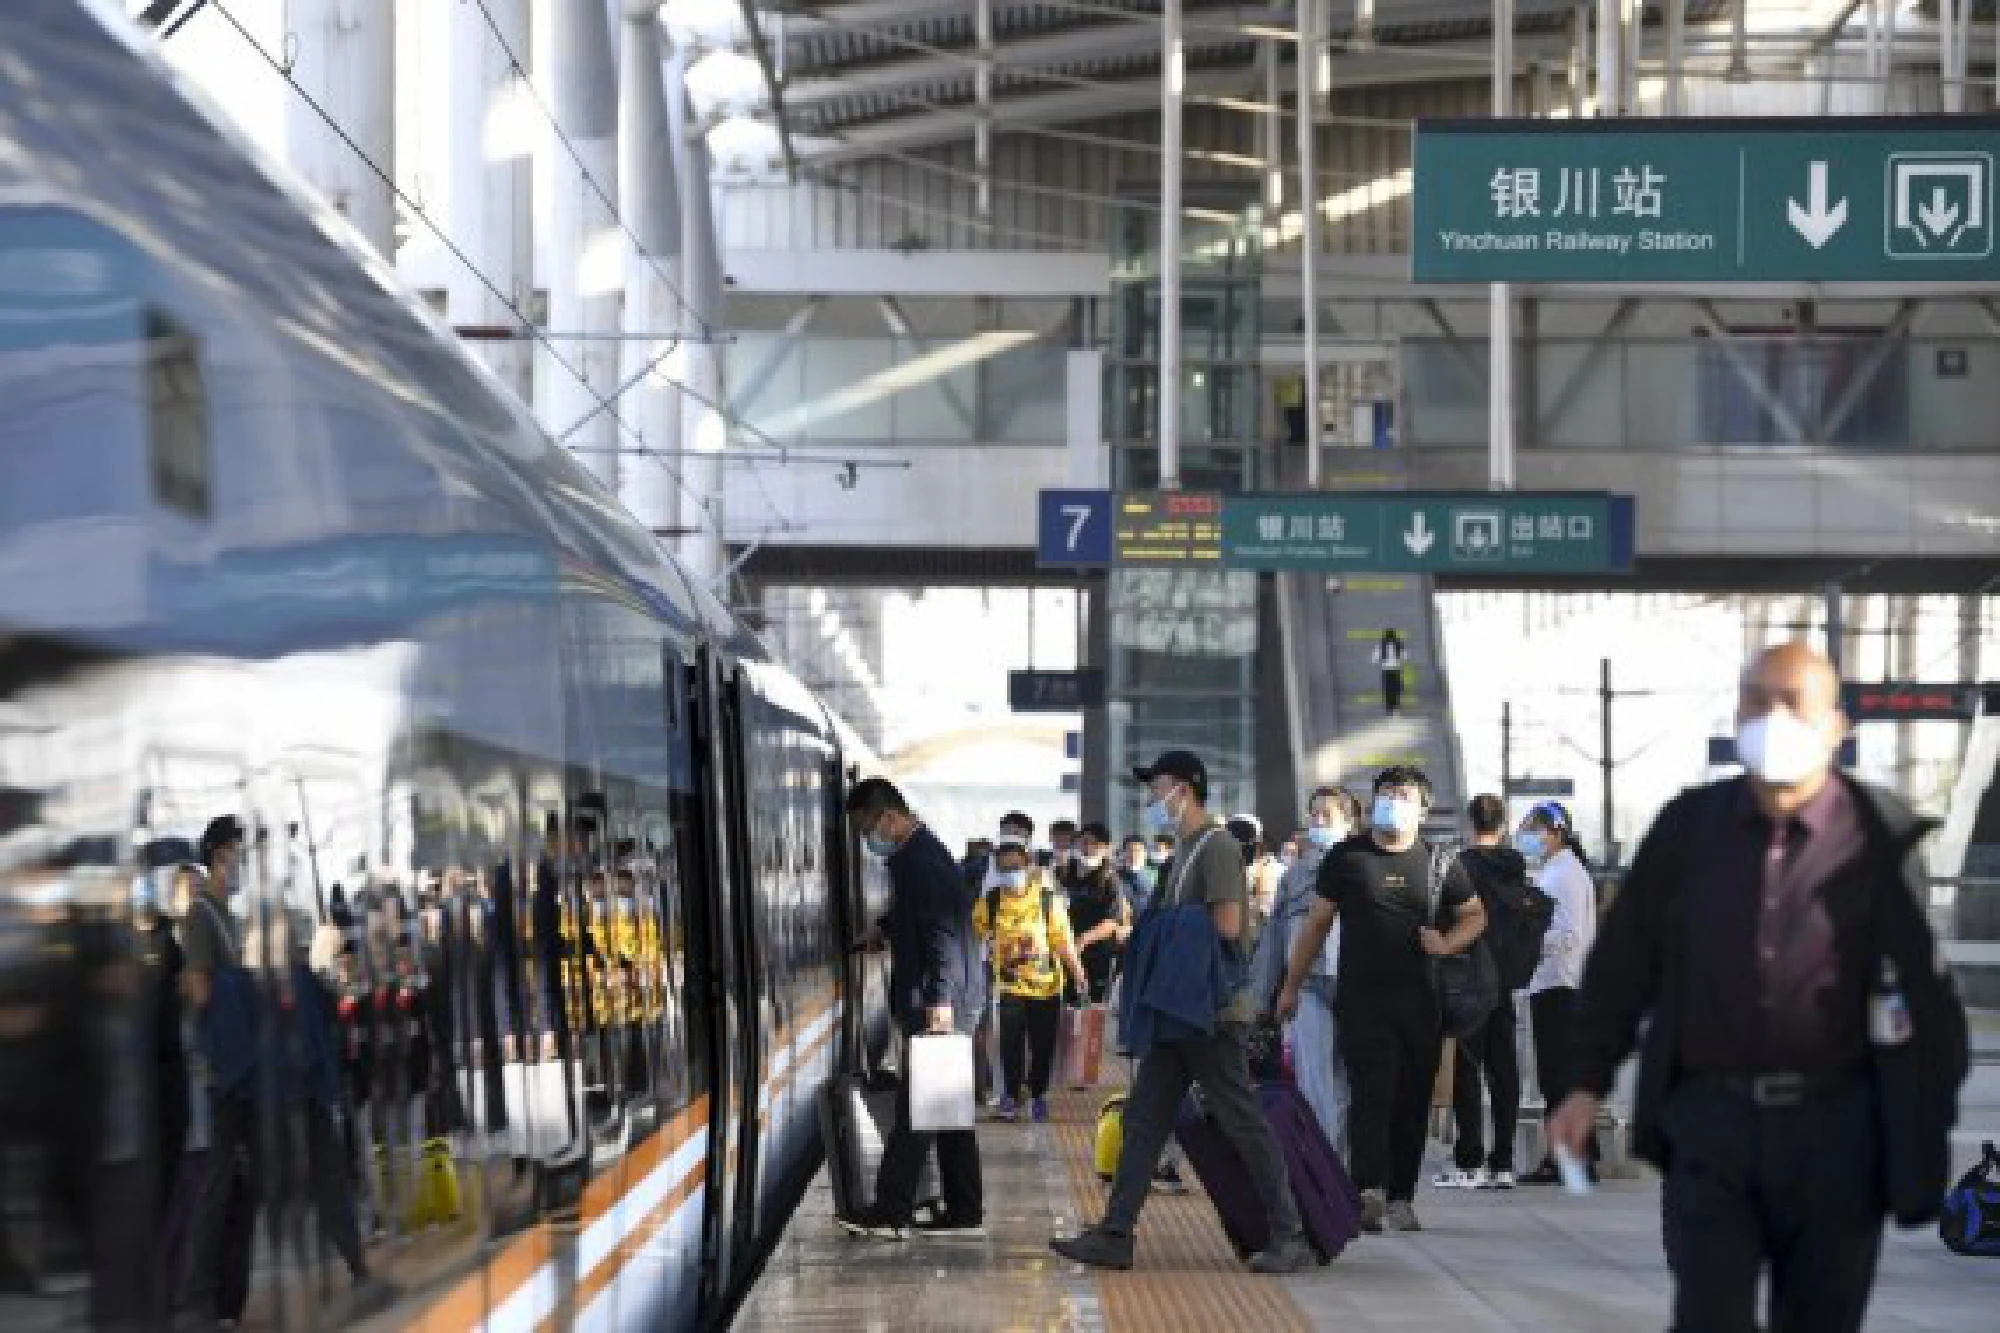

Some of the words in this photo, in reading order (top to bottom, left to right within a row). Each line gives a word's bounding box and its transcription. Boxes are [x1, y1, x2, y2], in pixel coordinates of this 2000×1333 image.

[1489, 163, 1667, 219] 银川站
[1439, 231, 1539, 252] Yinchuan
[1546, 231, 1633, 254] Railway
[1638, 231, 1714, 251] Station
[1060, 504, 1092, 551] 7
[1510, 513, 1594, 541] 出站口
